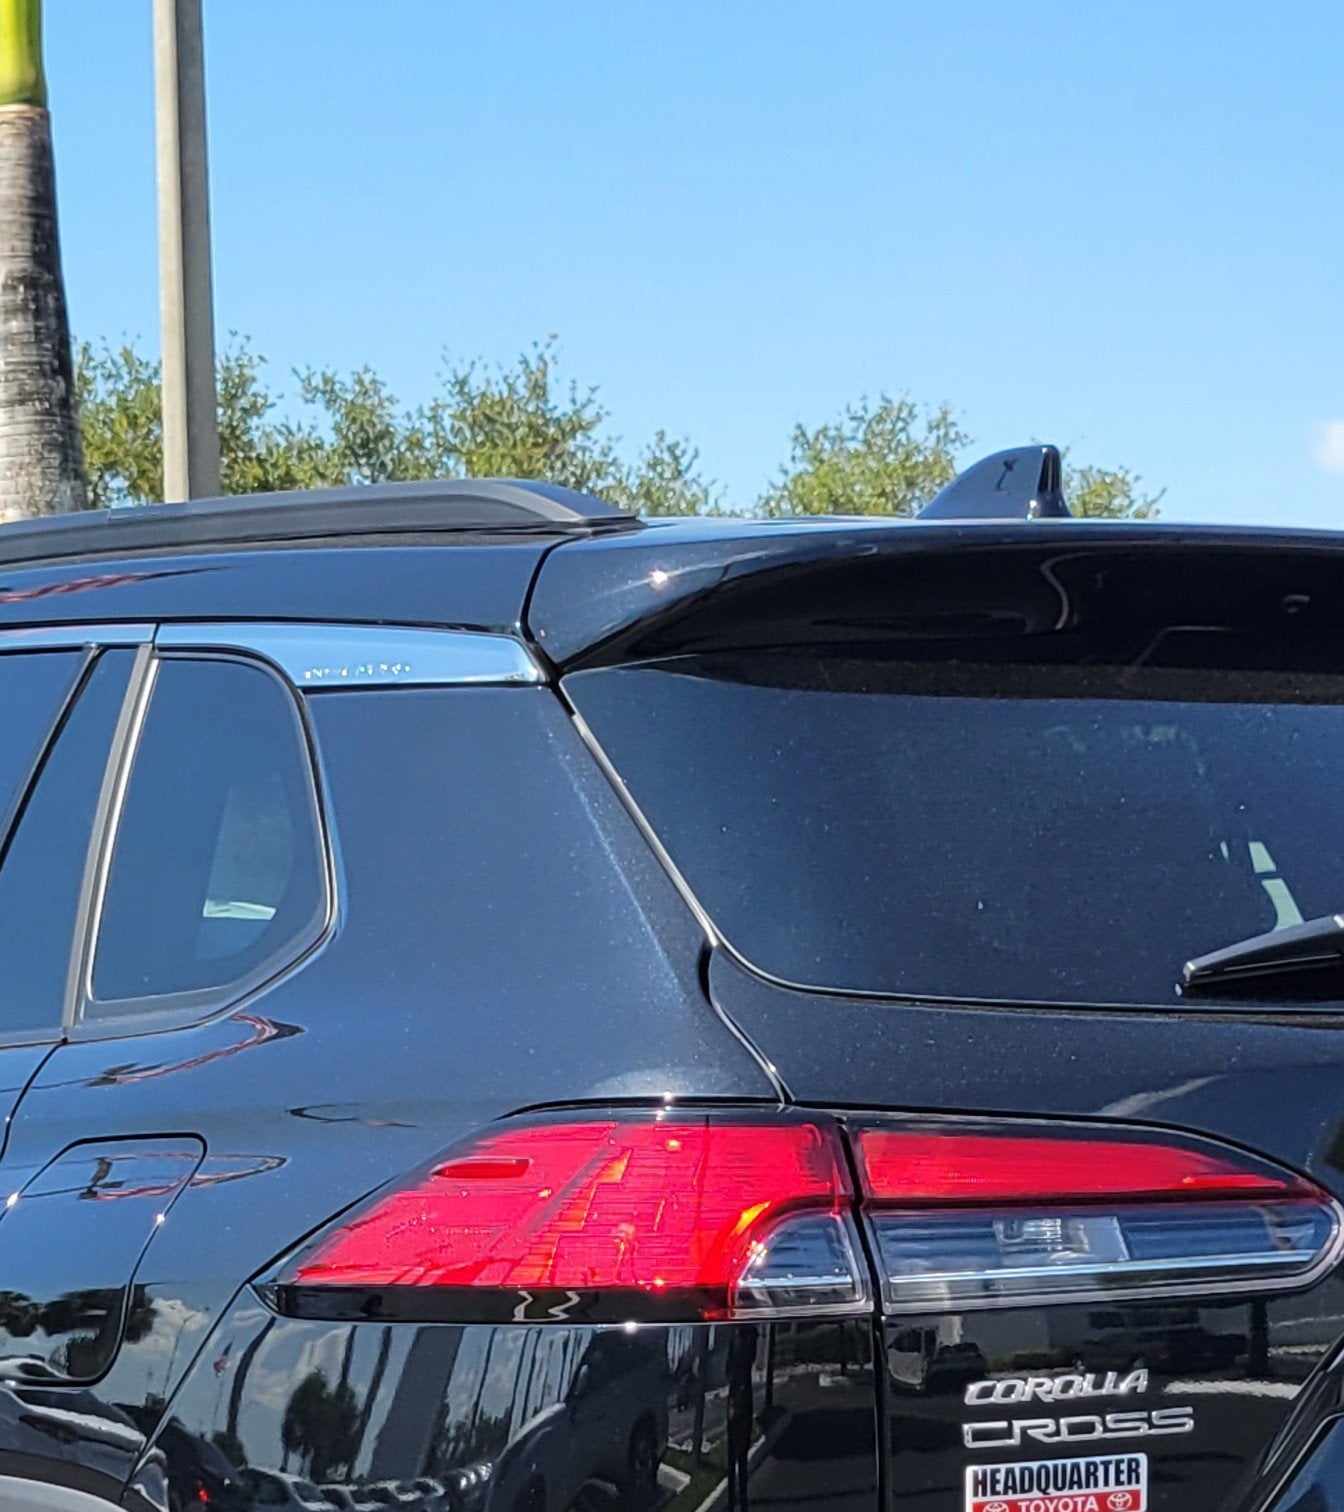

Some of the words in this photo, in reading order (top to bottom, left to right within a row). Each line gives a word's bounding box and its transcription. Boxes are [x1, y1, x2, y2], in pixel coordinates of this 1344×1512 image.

[963, 1368, 1149, 1405] COROLLA
[962, 1405, 1195, 1449] CROSS
[971, 1456, 1142, 1499] HEADQUARTER
